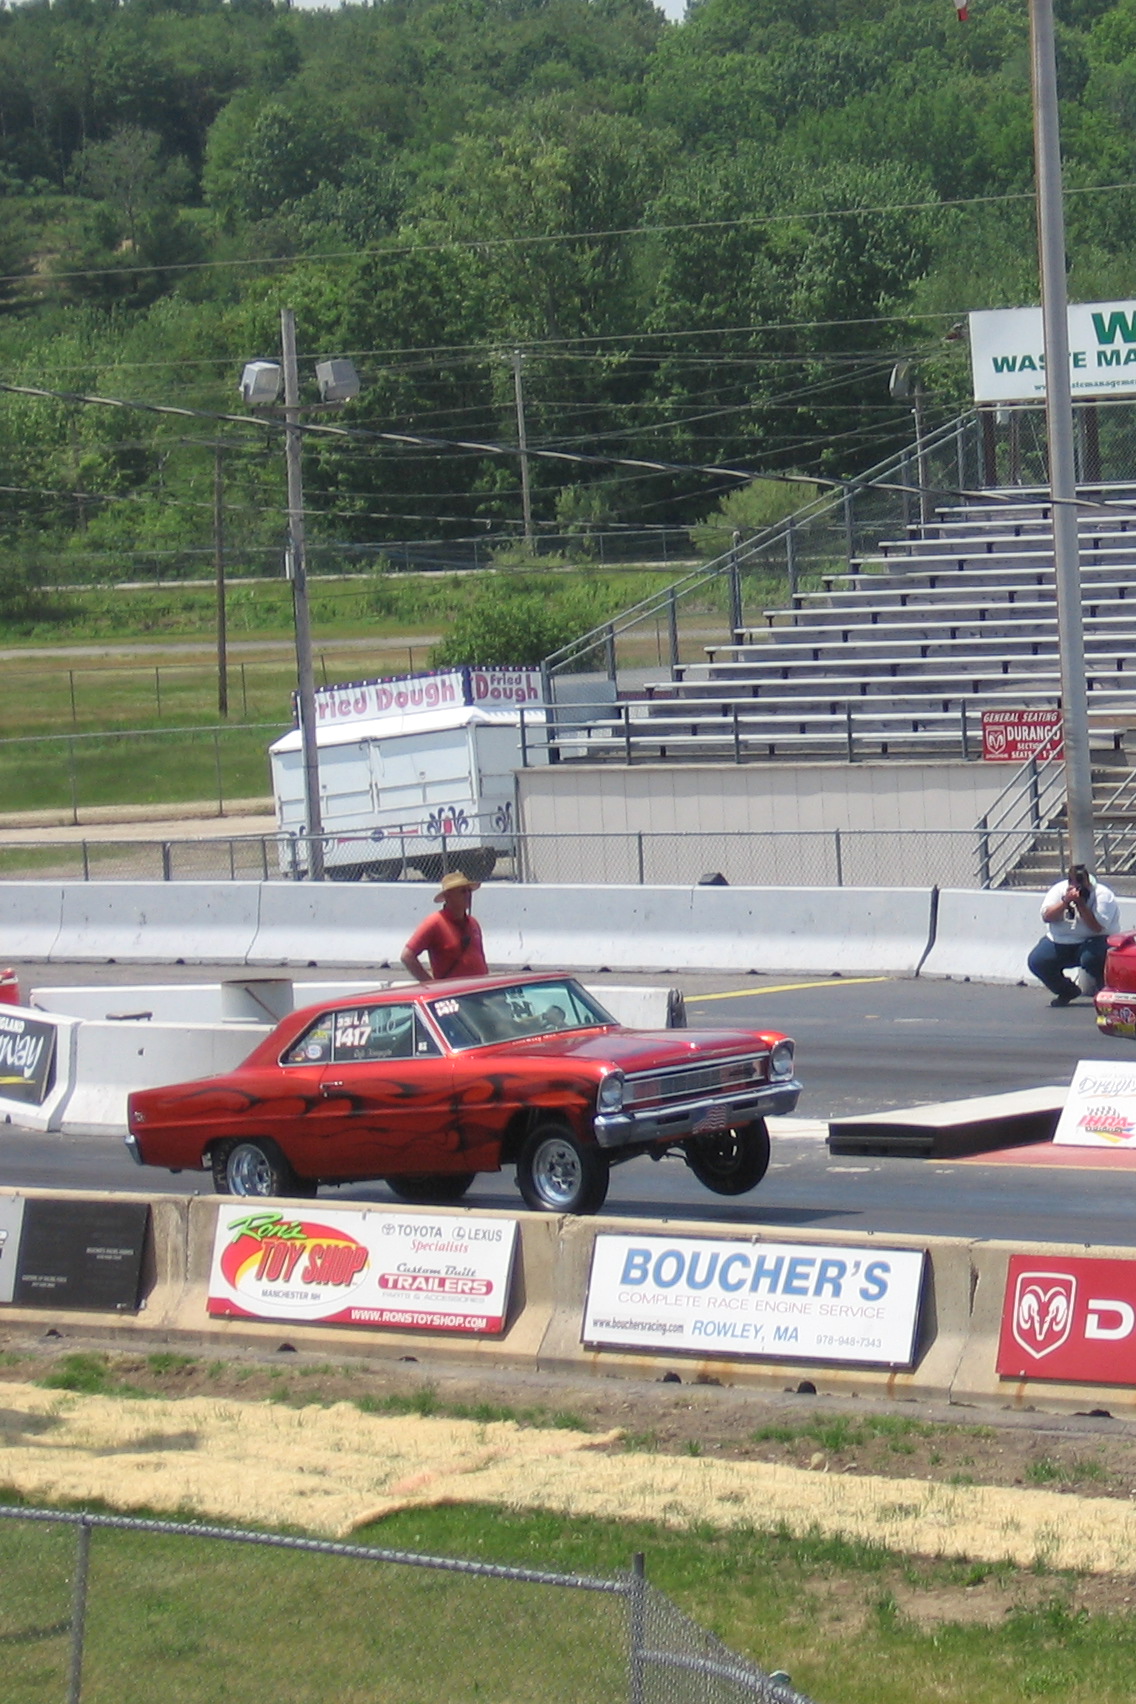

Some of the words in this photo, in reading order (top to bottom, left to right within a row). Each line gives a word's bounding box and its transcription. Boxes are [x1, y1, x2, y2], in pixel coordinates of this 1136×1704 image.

[992, 351, 1087, 374] WASE
[475, 673, 538, 703] Dough
[490, 673, 522, 686] Fried
[313, 690, 367, 719] ried
[376, 678, 456, 712] Dough
[983, 712, 1019, 723] GENERAL
[1022, 711, 1058, 722] SEATING
[335, 1026, 371, 1048] 1417
[227, 1212, 307, 1243] Ron's
[397, 1224, 443, 1238] TOYOTA
[467, 1228, 502, 1242] LEXUS
[409, 1239, 469, 1253] Specialists
[255, 1240, 306, 1282] TOY
[301, 1243, 369, 1287] SHOP
[397, 1262, 441, 1275] Custom
[445, 1265, 477, 1277] Built
[384, 1274, 488, 1295] TRAILERS
[619, 1247, 892, 1302] BOUCHER'S
[261, 1289, 309, 1300] MANCHESTER
[310, 1292, 321, 1300] NH
[618, 1291, 701, 1309] COMPLETE
[706, 1297, 748, 1312] RACE
[755, 1300, 813, 1316] ENGINE
[818, 1303, 886, 1320] SERVICE
[351, 1309, 487, 1328] WWW.RONSTOYSHOP.COM
[592, 1316, 685, 1336] www.bouchersracing.com
[691, 1320, 765, 1342] ROWLEY,
[773, 1325, 800, 1343] MA
[815, 1334, 883, 1349] 978-948-7343
